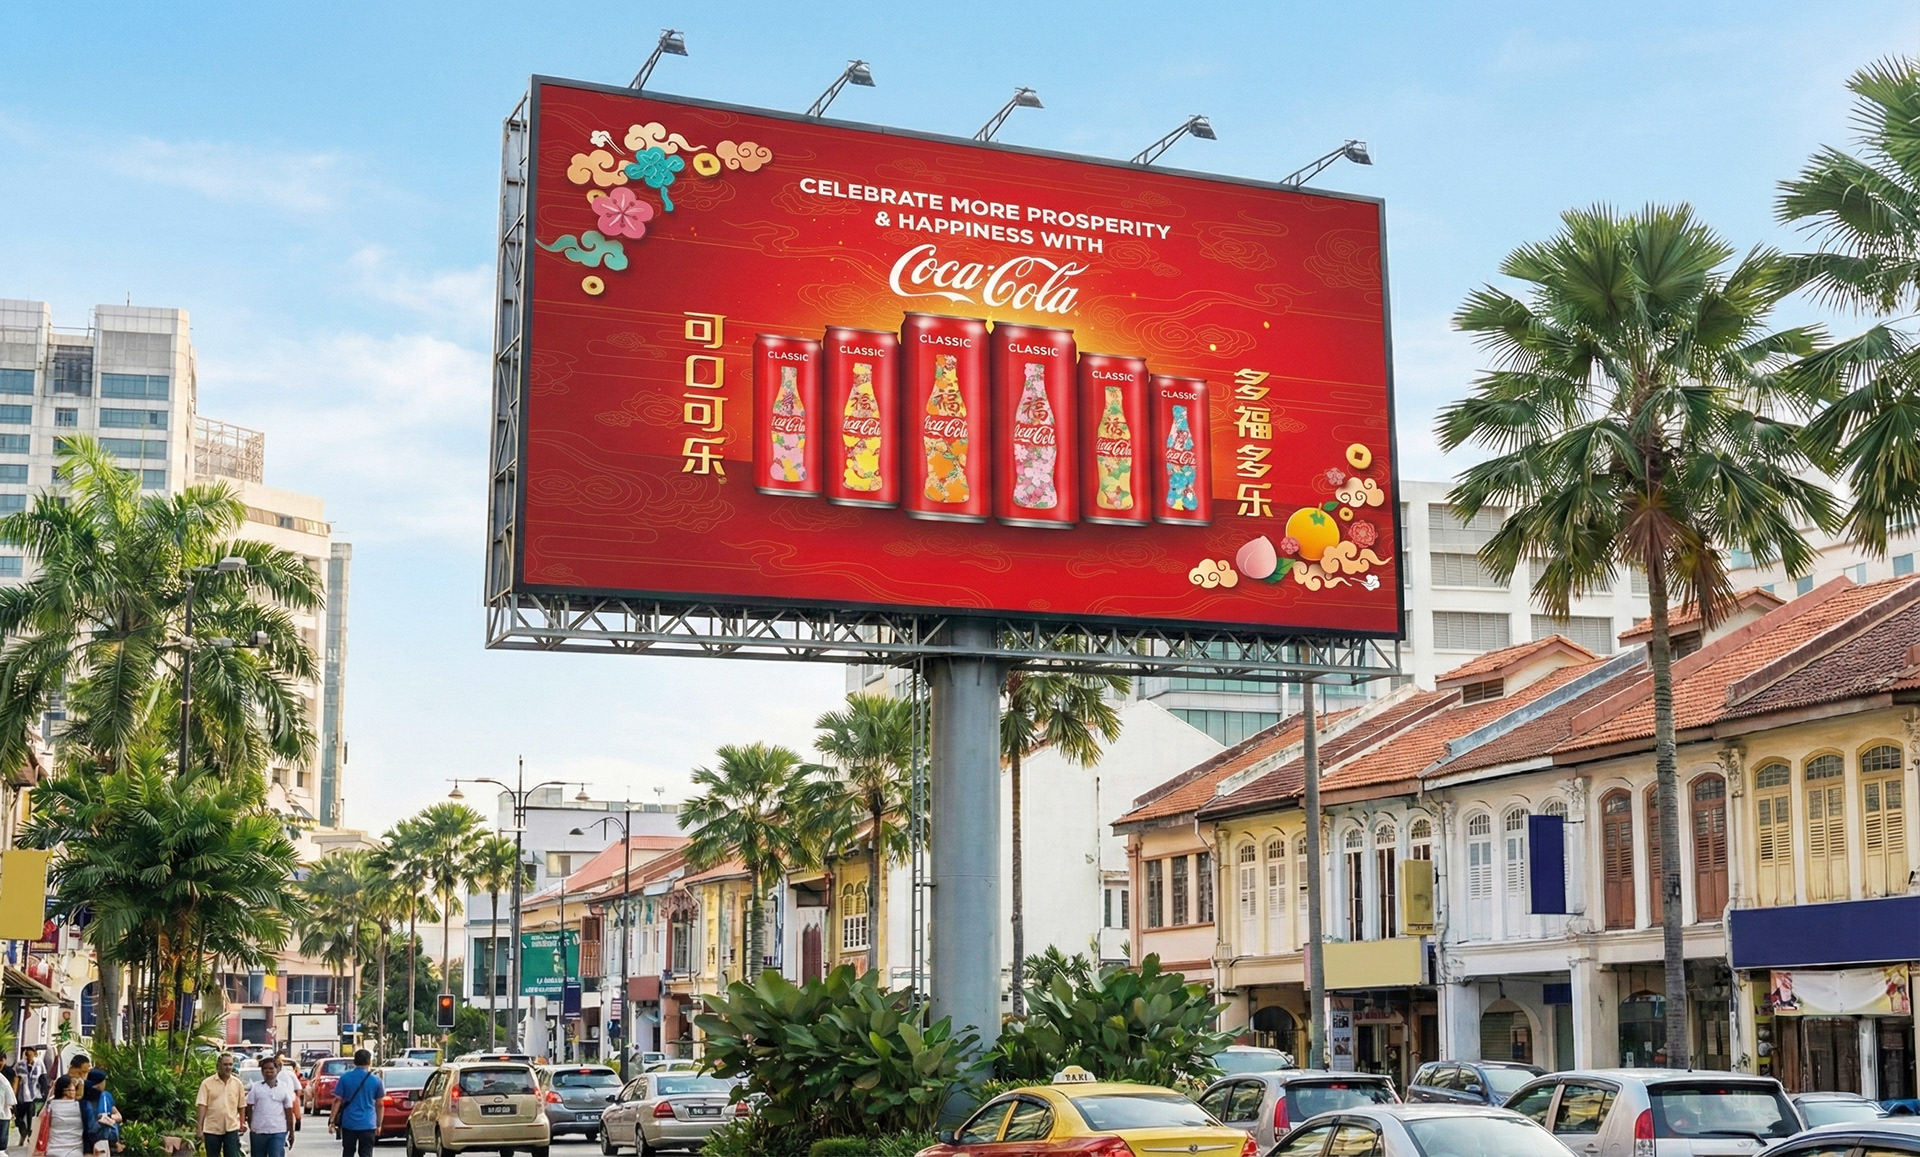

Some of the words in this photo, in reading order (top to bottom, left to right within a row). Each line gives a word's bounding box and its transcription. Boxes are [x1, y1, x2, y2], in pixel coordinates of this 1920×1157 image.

[799, 177, 944, 211] CELEBRATE
[950, 196, 1020, 221] MORE
[1027, 206, 1171, 240] PROSPERITY
[874, 210, 891, 227] &
[898, 213, 1034, 245] HAPPINESS
[1041, 231, 1103, 254] WITH
[888, 243, 1090, 315] Coca-Cola
[919, 334, 972, 348] CLASSIC
[767, 350, 809, 362] CLASSIC
[839, 345, 885, 358] CLASSIC
[1008, 342, 1059, 358] CLASSIC
[1091, 369, 1135, 382] CLASSIC
[681, 311, 729, 476] 可口可乐
[1160, 389, 1198, 401] CLASSIC
[1233, 368, 1274, 517] 多福多乐
